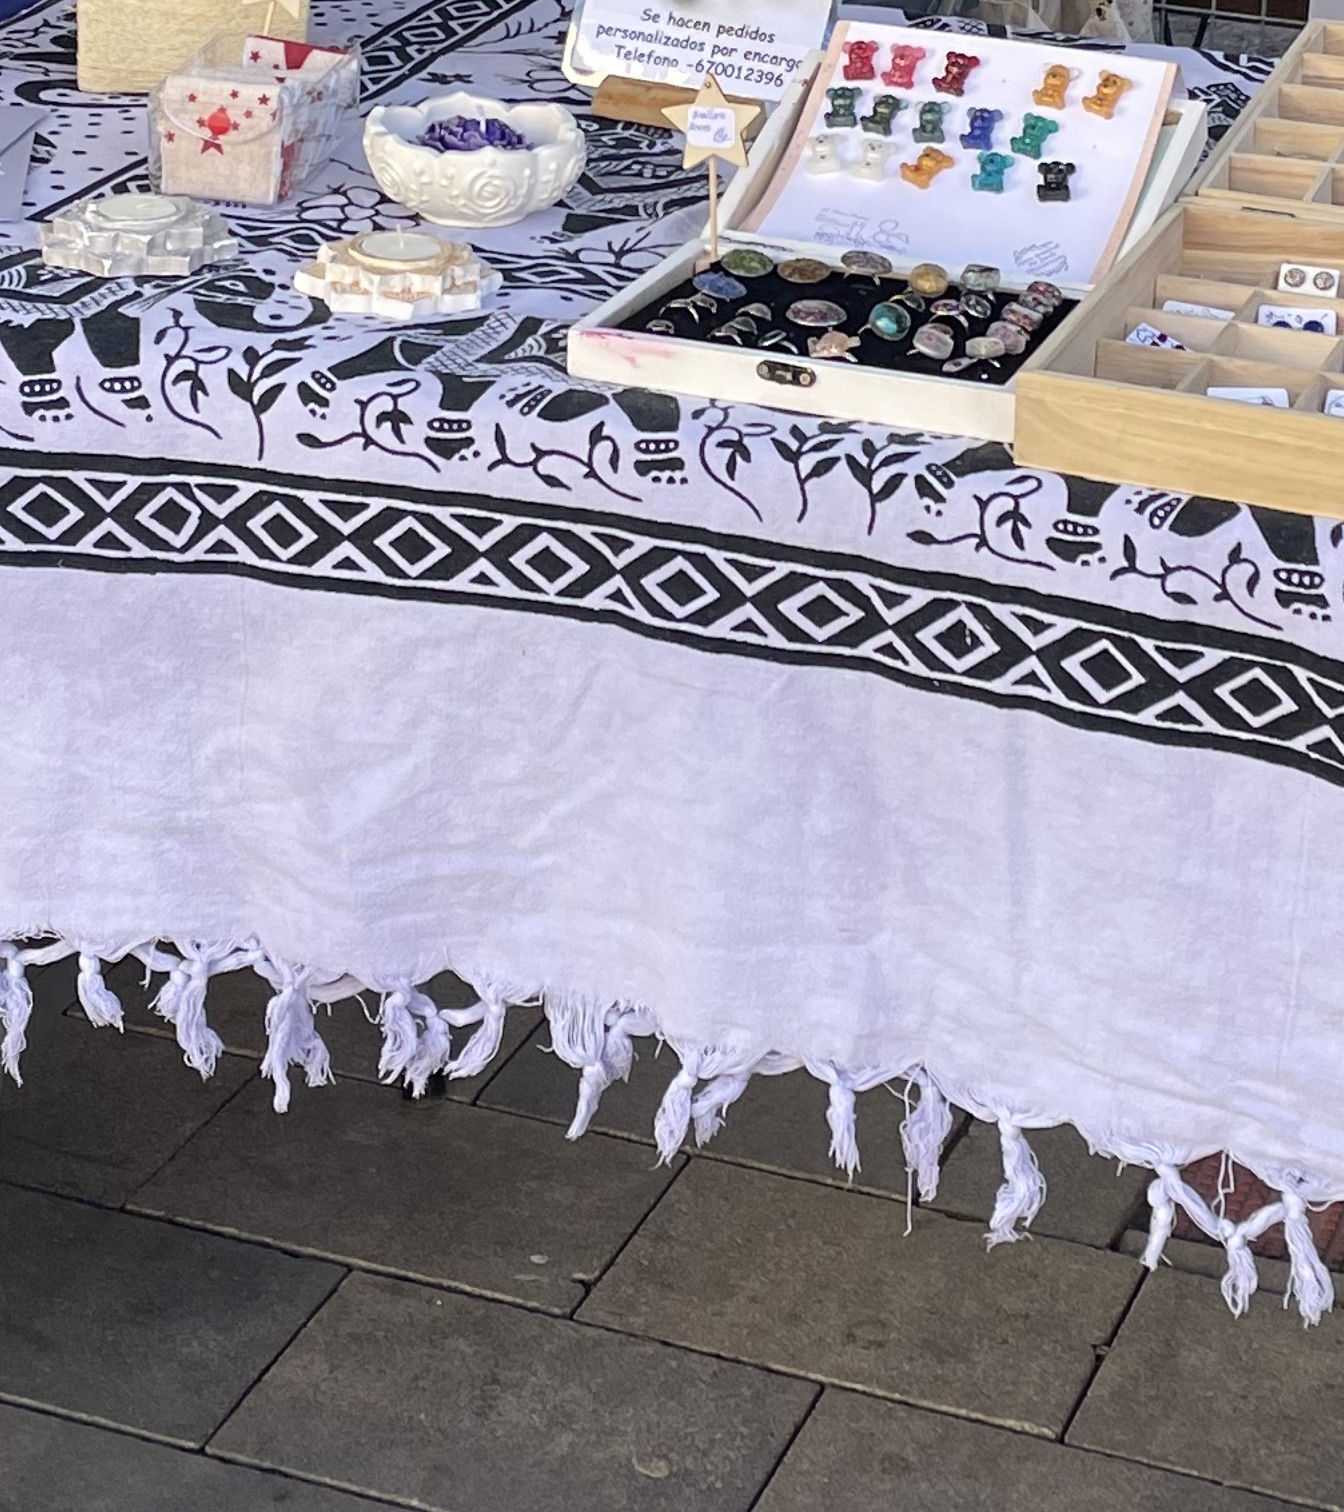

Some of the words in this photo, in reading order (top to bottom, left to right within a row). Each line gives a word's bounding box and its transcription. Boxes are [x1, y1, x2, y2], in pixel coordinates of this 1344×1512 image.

[596, 23, 705, 52] personalizados
[712, 42, 738, 59] por
[640, 9, 661, 25] Se
[667, 12, 711, 33] hacen
[717, 19, 776, 44] pedidos
[615, 45, 680, 68] Telefono
